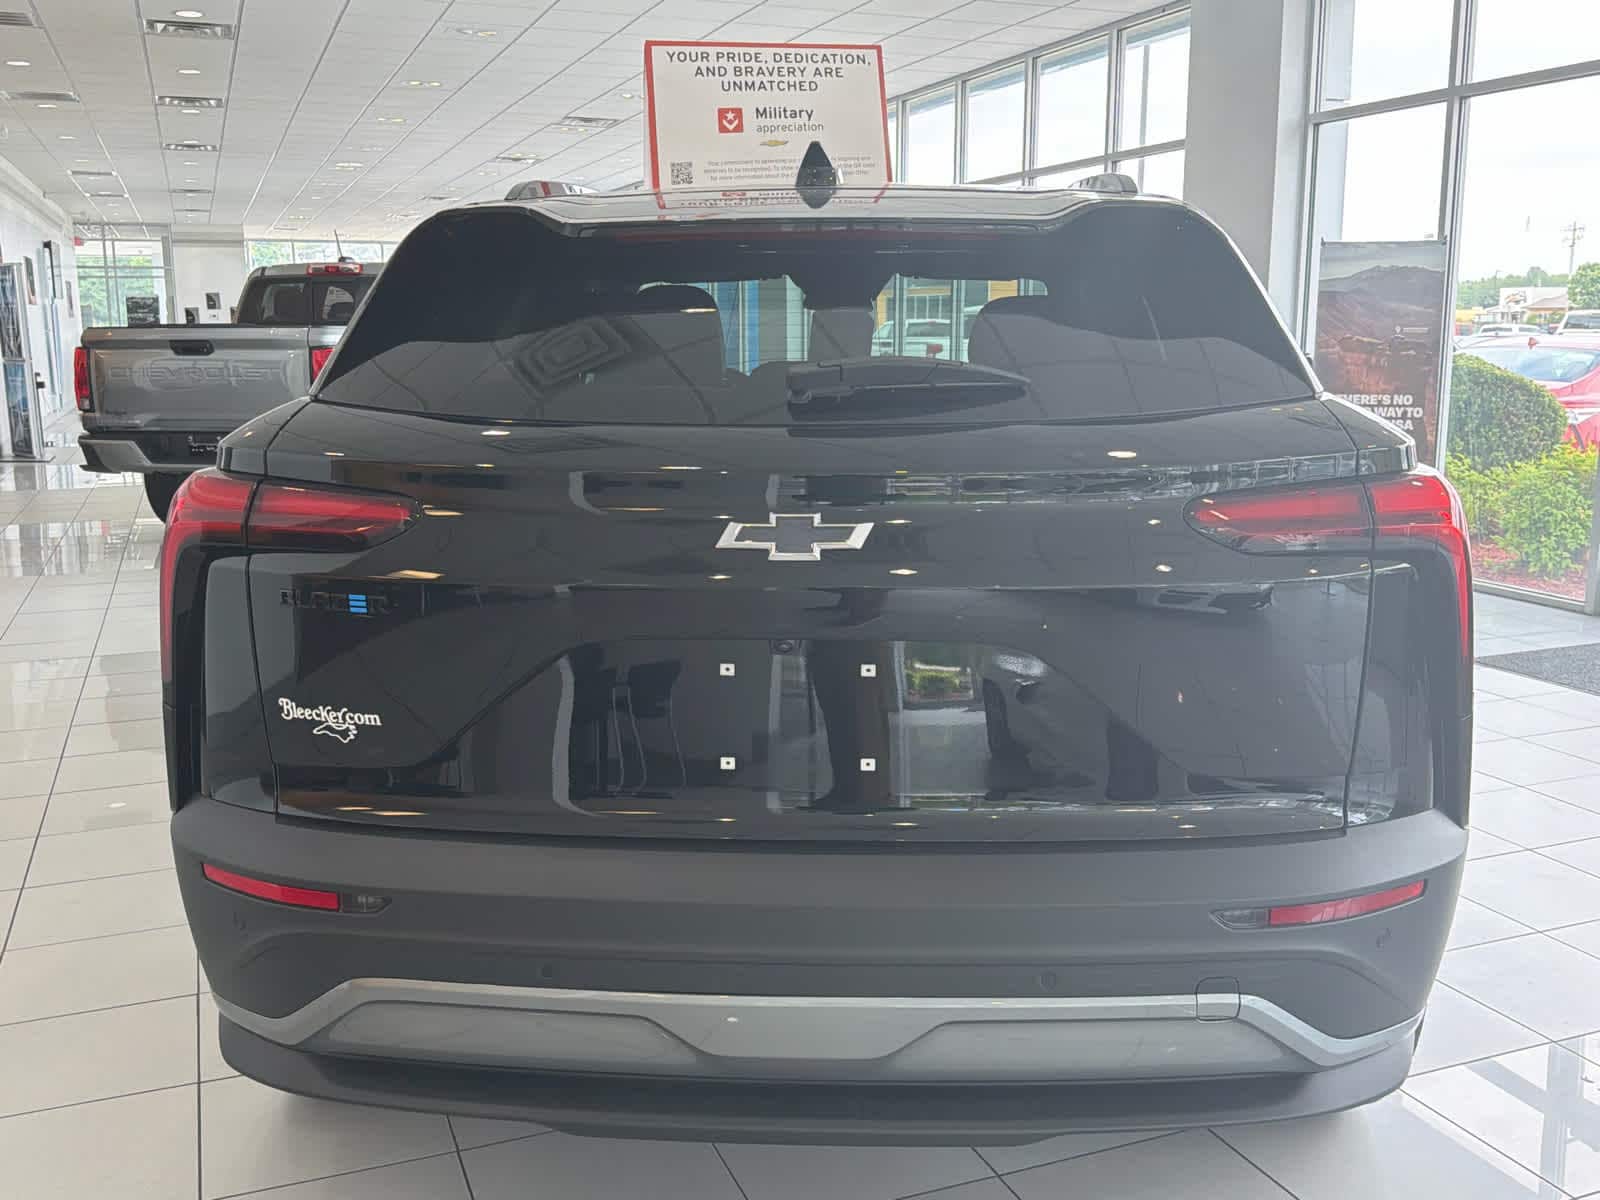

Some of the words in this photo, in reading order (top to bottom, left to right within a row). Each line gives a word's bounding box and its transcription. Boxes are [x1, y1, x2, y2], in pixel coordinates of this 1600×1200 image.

[666, 51, 710, 63] YOUR
[716, 52, 768, 64] PRIDE,
[773, 53, 871, 66] DEDICATION,
[694, 66, 728, 77] AND
[733, 66, 807, 77] BRAVERY
[813, 67, 844, 78] ARE
[721, 80, 818, 92] UNMATCHED
[755, 107, 814, 121] Military
[756, 122, 824, 134] appreciation
[1393, 394, 1413, 405] NO
[1375, 407, 1406, 418] WAY
[1406, 407, 1423, 418] TO
